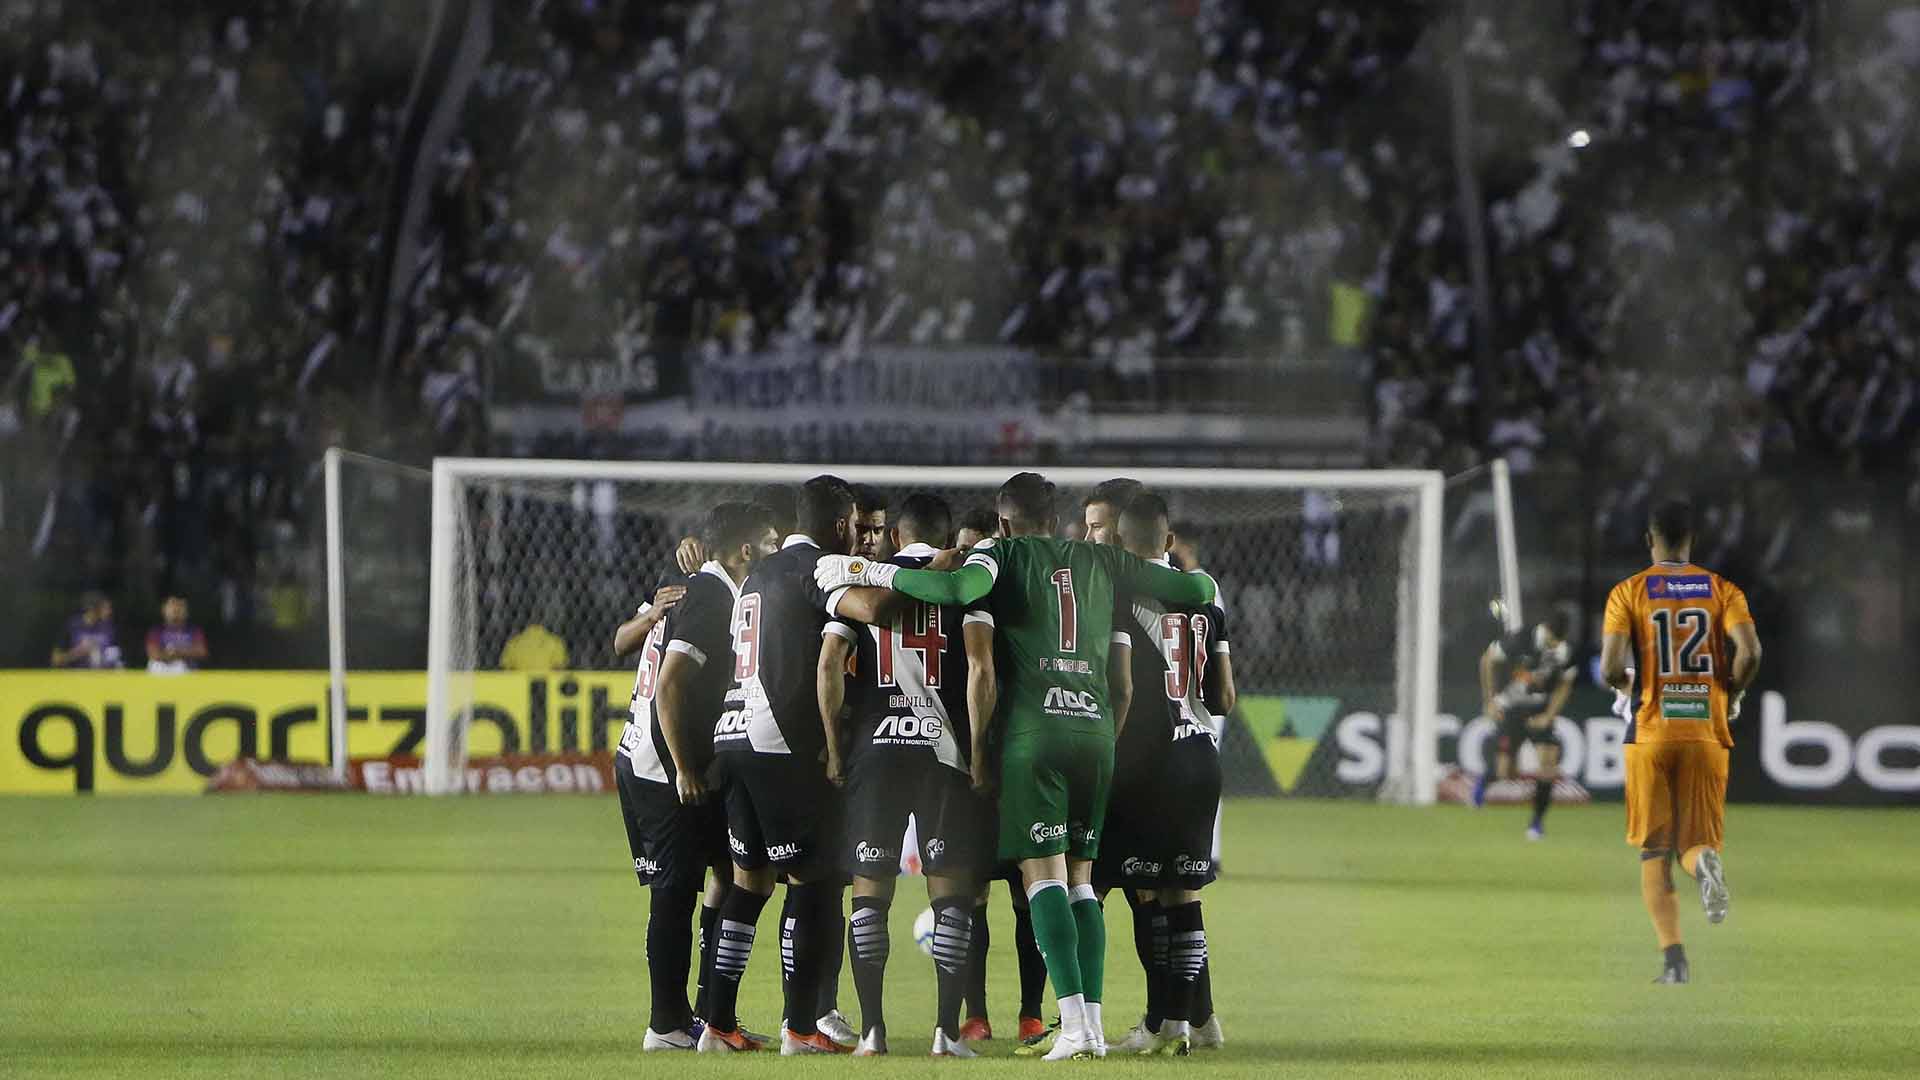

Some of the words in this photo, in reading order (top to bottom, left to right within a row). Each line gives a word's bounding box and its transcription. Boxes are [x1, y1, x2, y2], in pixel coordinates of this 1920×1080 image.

[876, 600, 949, 689] 14
[1051, 568, 1077, 653] 1
[1649, 606, 1714, 676] 12
[873, 715, 943, 739] AOC
[889, 694, 933, 708] DANILO
